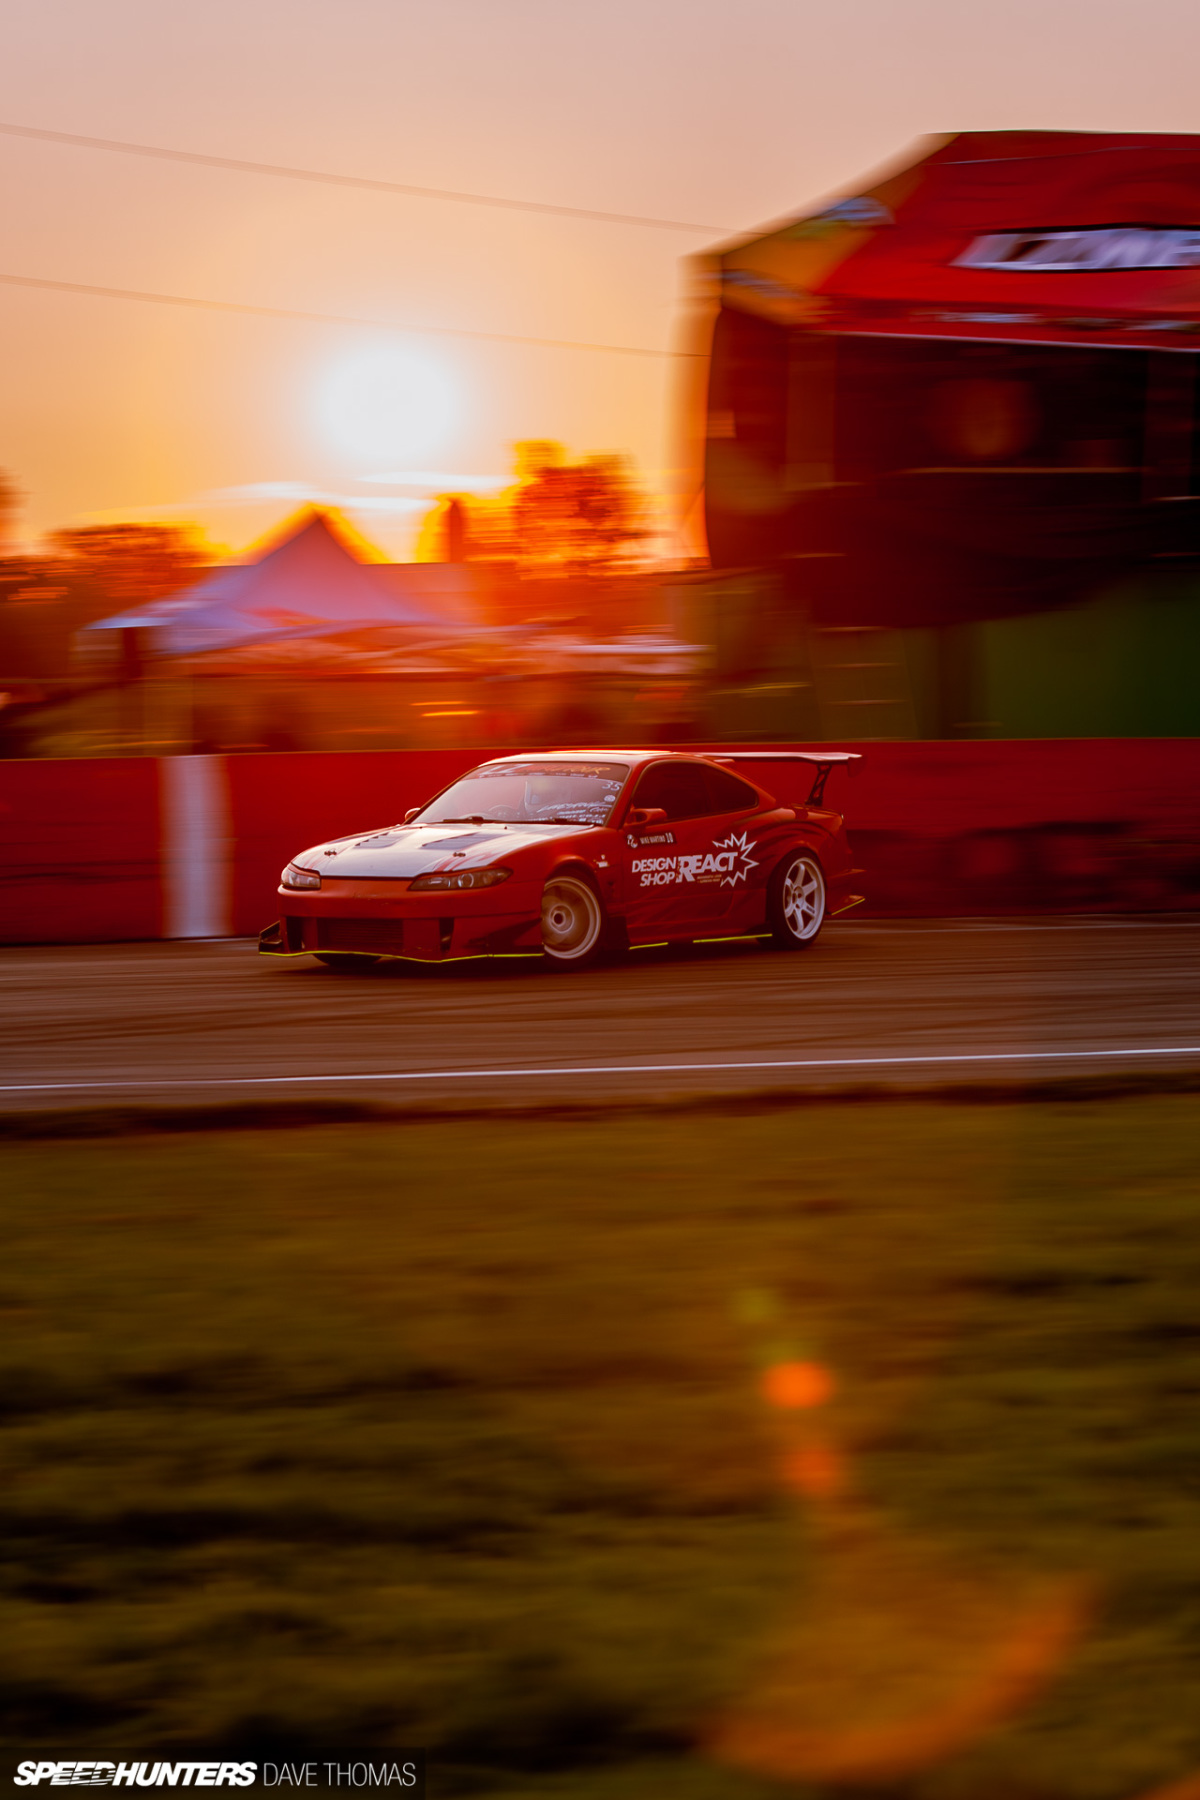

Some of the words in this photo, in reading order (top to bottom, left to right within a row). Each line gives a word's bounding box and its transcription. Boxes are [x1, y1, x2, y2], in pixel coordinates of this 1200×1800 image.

[602, 782, 620, 792] 35
[632, 856, 677, 873] DESIGN
[675, 851, 738, 883] REACT
[640, 871, 675, 887] SHOP
